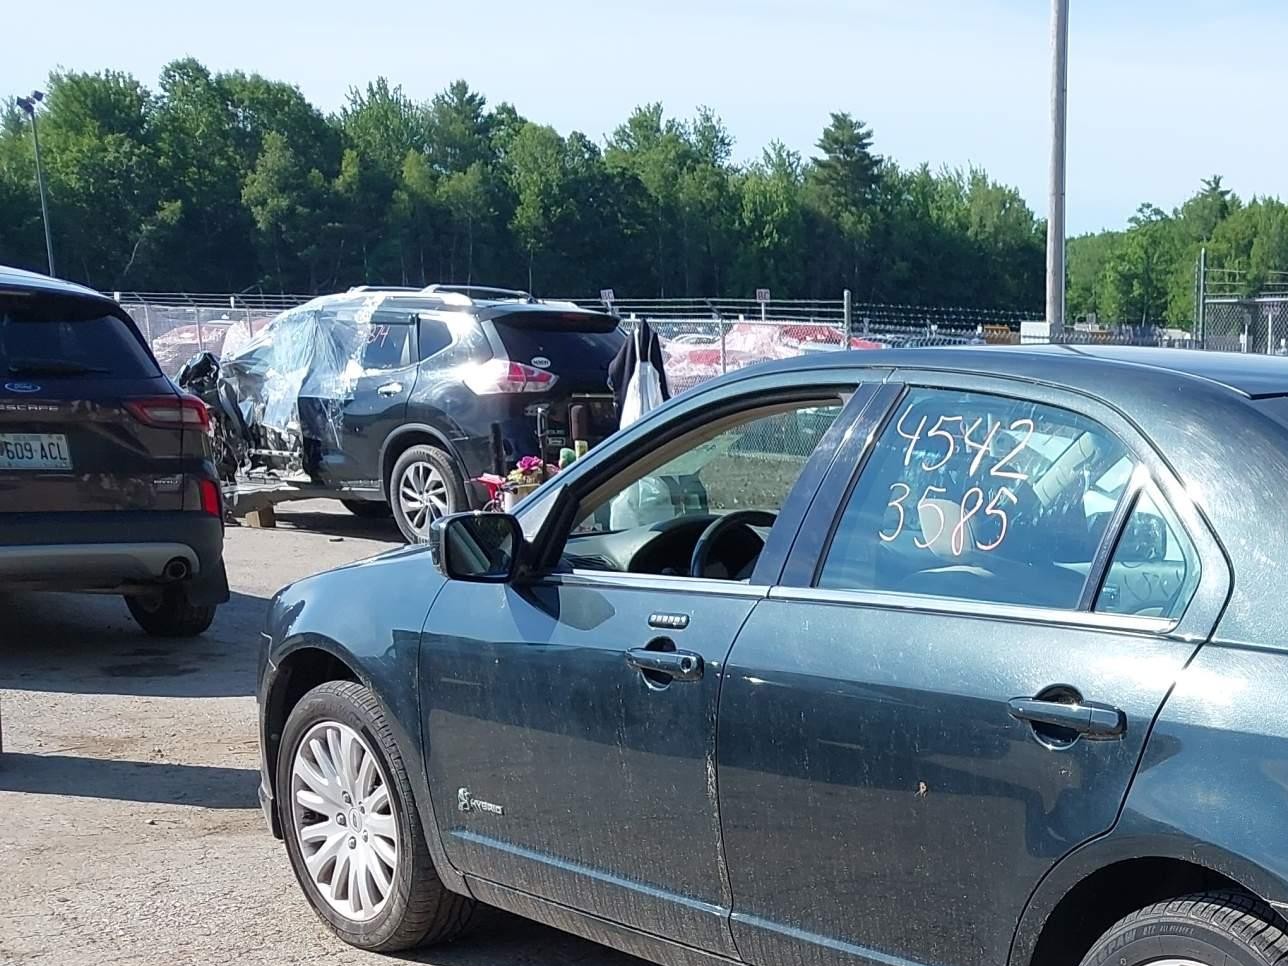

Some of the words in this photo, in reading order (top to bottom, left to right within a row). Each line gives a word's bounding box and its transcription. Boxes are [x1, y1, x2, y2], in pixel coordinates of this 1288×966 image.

[40, 442, 67, 460] ACL
[896, 404, 1034, 480] 4542
[878, 483, 1018, 556] 3585
[470, 799, 504, 815] HYBRID
